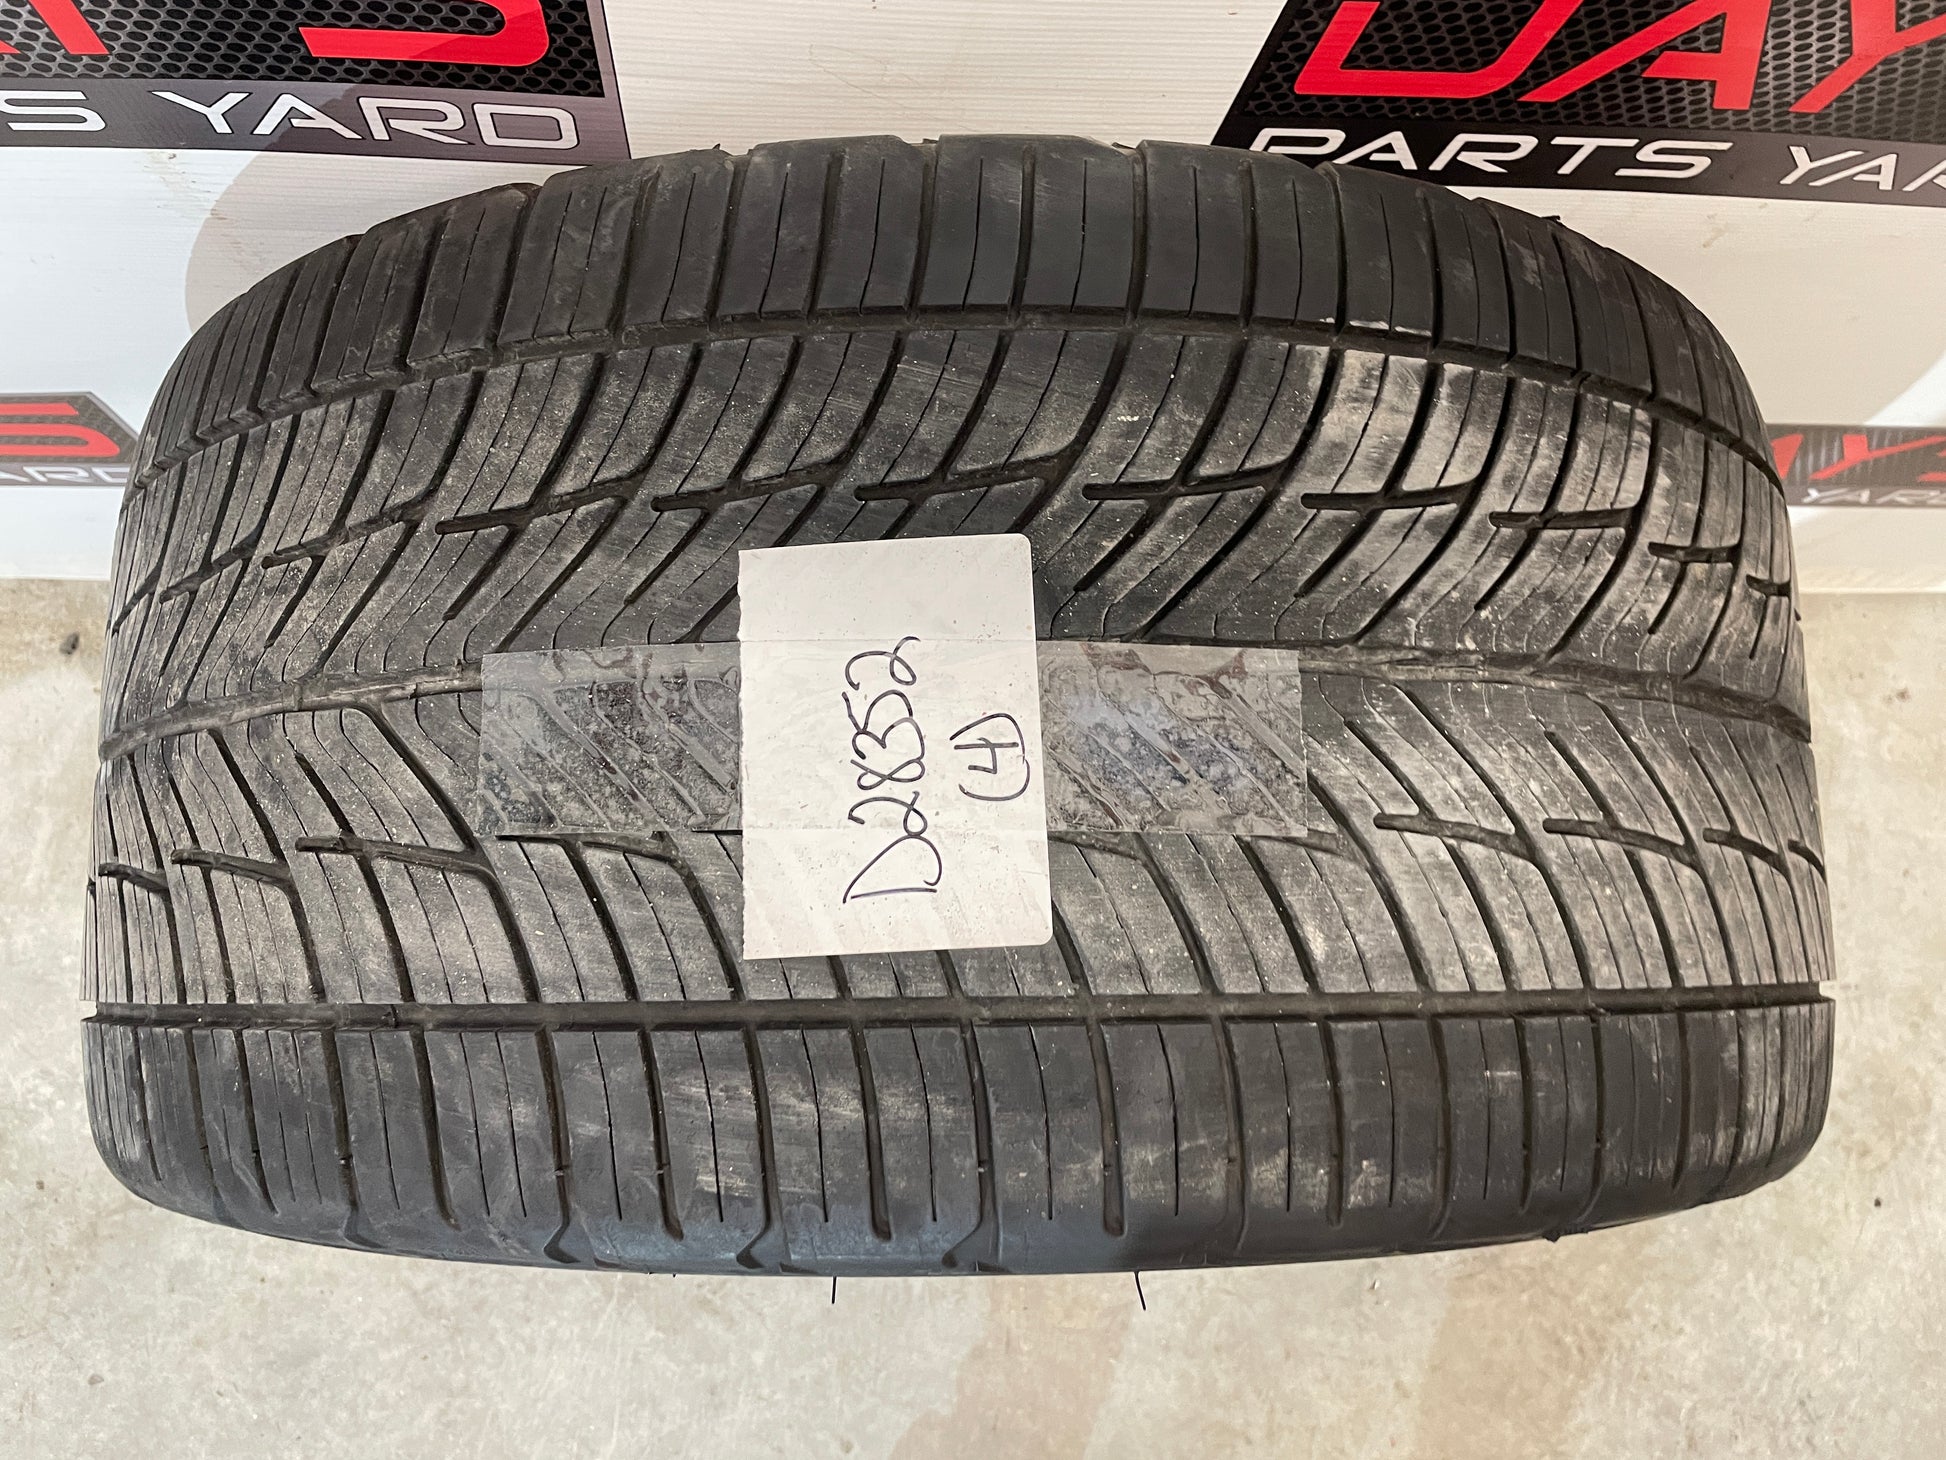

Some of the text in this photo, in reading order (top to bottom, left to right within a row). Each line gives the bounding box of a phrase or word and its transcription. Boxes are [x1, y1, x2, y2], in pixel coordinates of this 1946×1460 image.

[151, 90, 579, 150] YARD
[1248, 127, 1733, 181] PARTS
[842, 635, 943, 904] D28352
